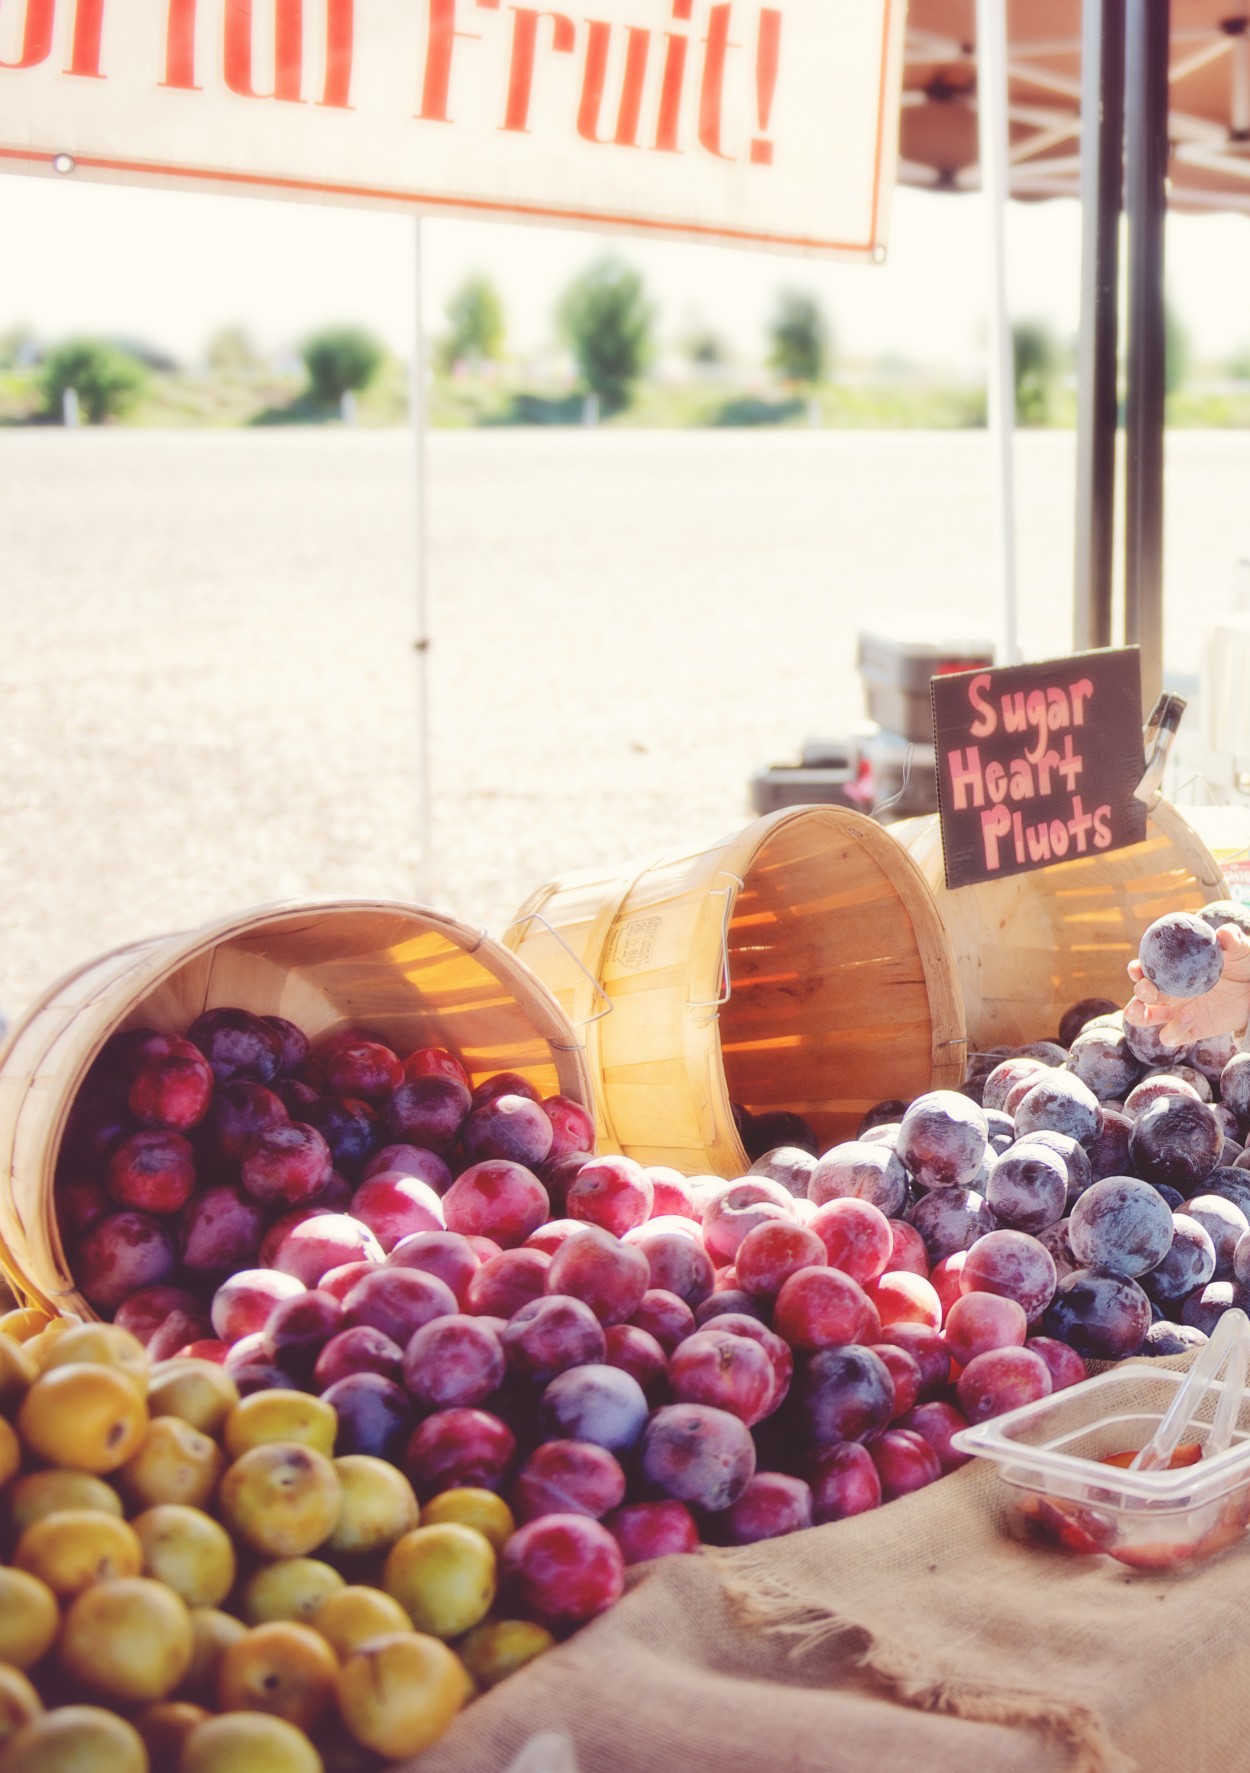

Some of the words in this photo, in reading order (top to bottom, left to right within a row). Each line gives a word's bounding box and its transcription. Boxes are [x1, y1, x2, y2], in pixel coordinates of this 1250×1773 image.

[413, 0, 782, 166] Fruit!
[968, 674, 1094, 764] Sugar
[948, 735, 1083, 811] Heart
[980, 795, 1112, 871] Pluots
